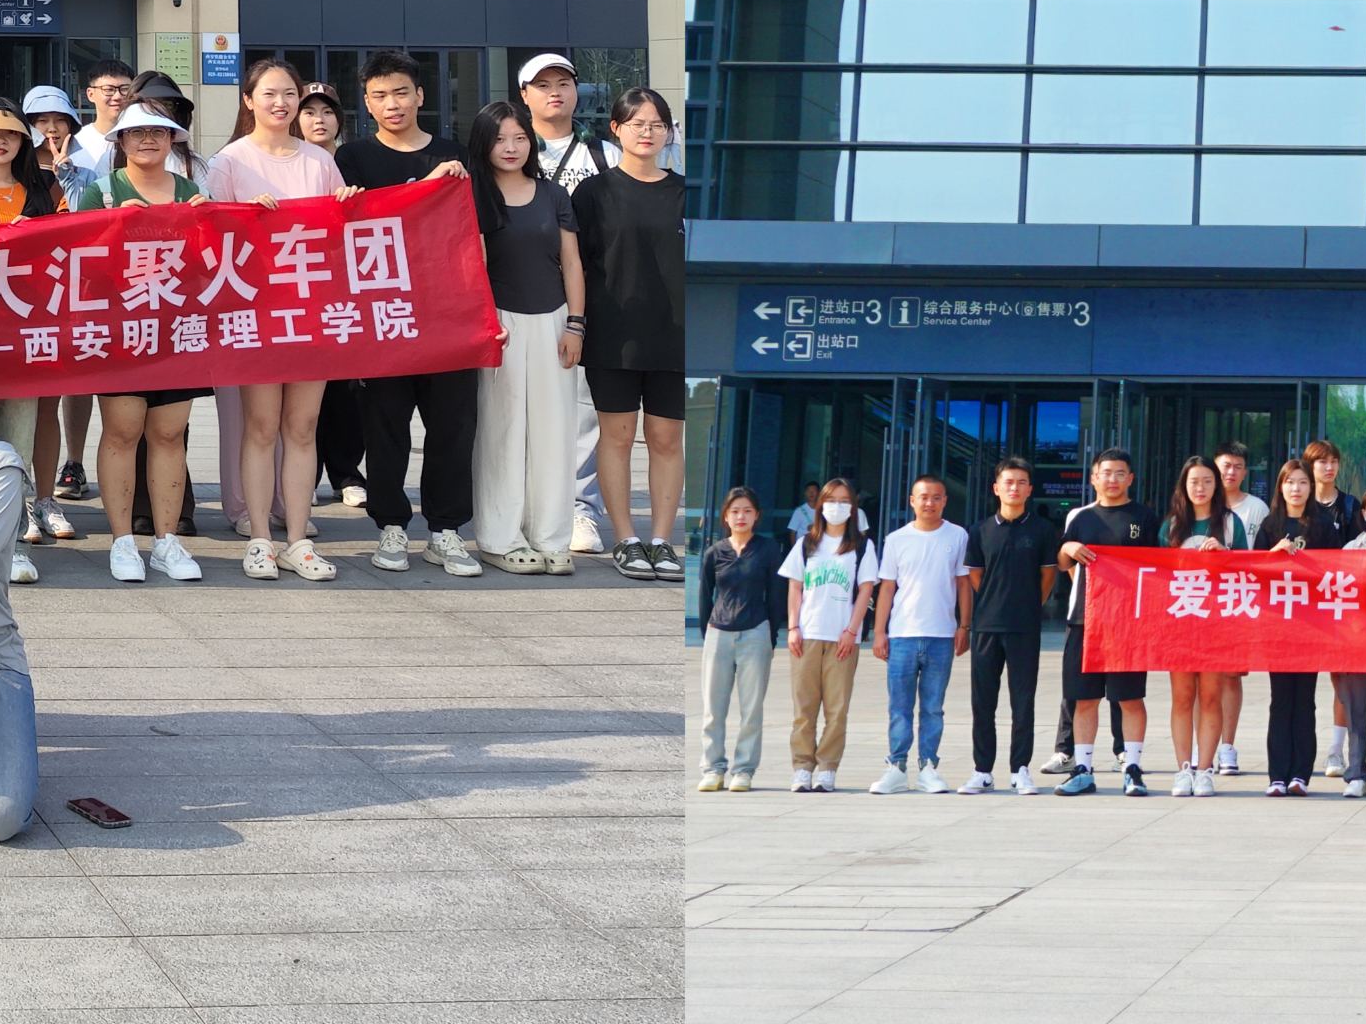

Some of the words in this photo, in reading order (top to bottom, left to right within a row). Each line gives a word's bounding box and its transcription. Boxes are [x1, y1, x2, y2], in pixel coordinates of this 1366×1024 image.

[820, 299, 865, 314] 进站口
[865, 299, 882, 325] 3
[1073, 301, 1090, 327] 3
[818, 316, 856, 324] Entrance
[923, 317, 957, 326] Service
[960, 317, 991, 326] Center
[816, 334, 858, 349] 出站口
[816, 350, 833, 359] Exit
